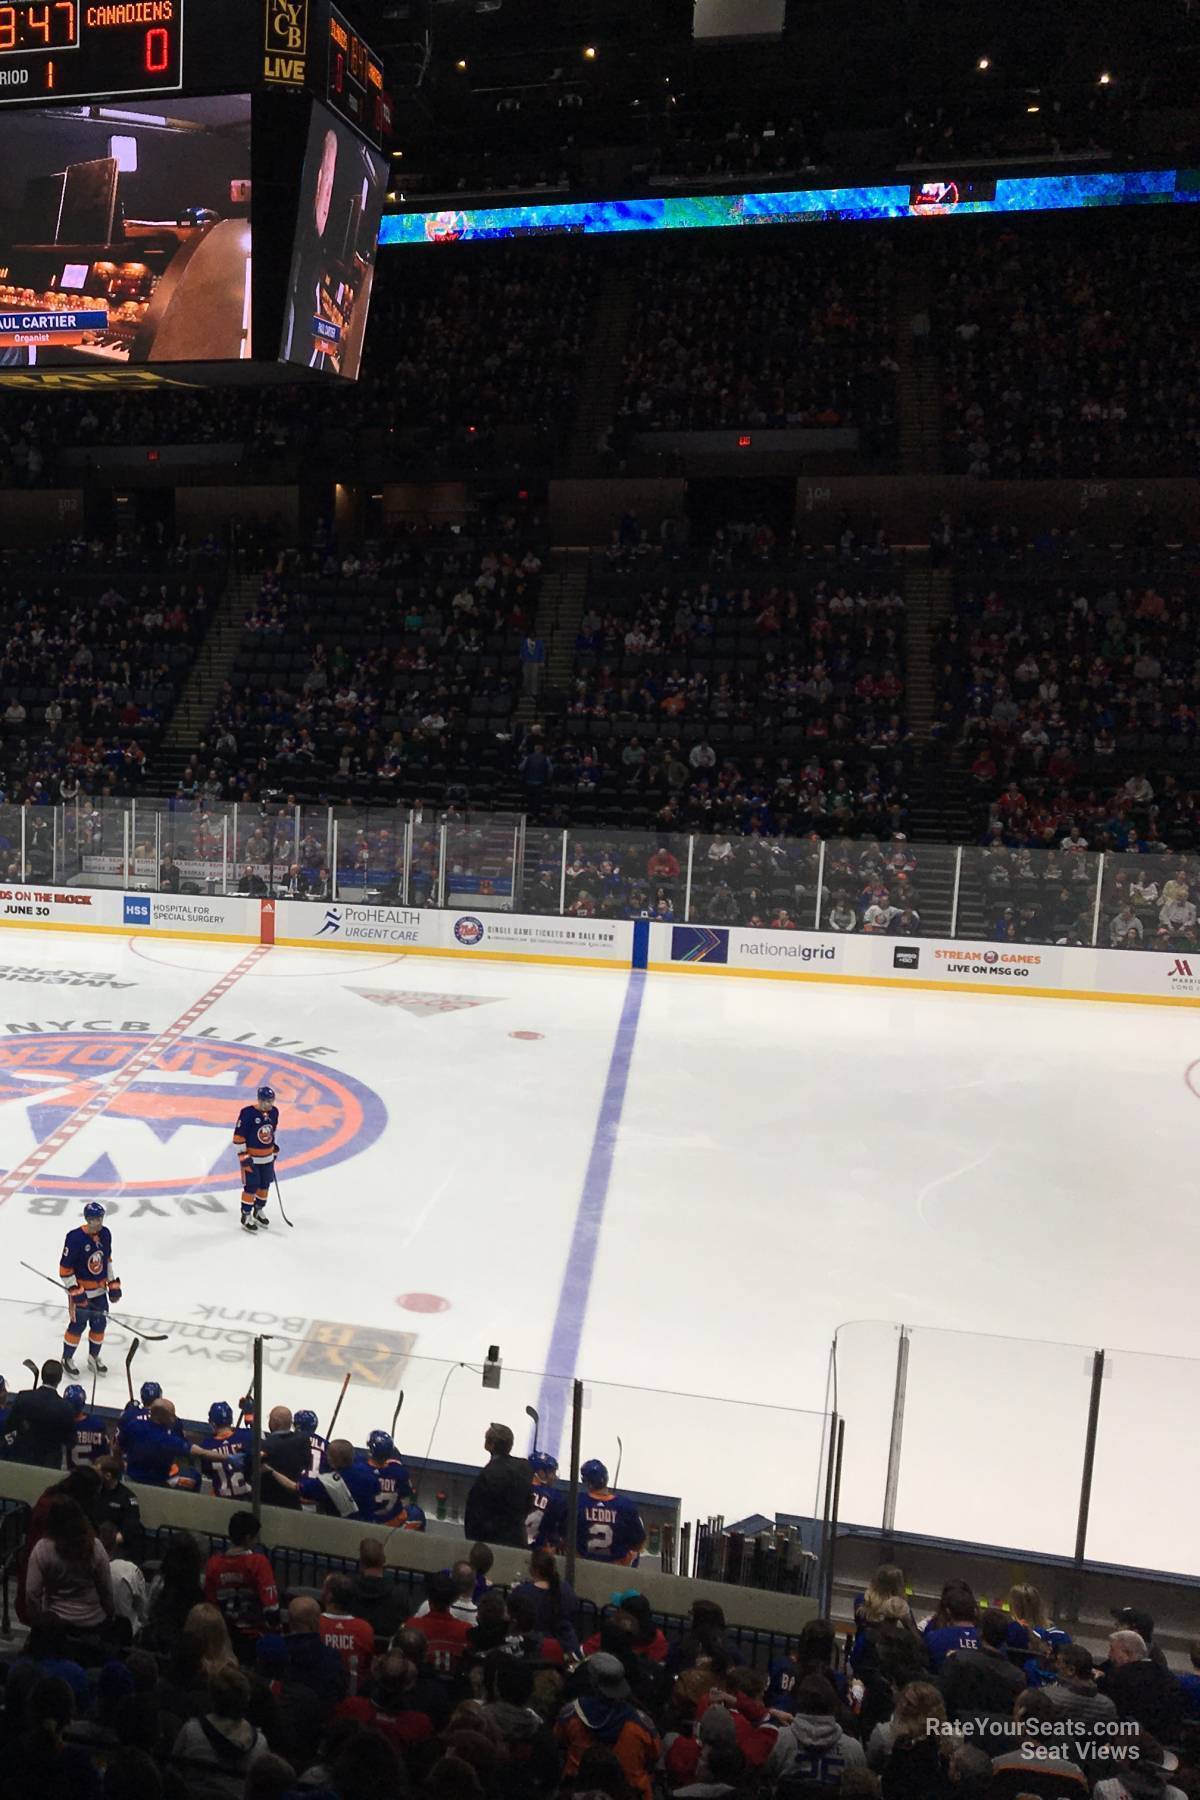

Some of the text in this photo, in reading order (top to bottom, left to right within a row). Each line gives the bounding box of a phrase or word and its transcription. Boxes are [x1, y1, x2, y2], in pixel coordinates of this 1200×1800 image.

[87, 1, 172, 27] CANADIENS
[146, 28, 169, 72] 0
[264, 57, 305, 80] LIVE
[22, 315, 77, 329] CARTIER
[14, 333, 50, 345] Organist
[15, 892, 32, 902] ON
[34, 893, 53, 903] THE
[4, 905, 50, 916] JUNE 30
[126, 906, 148, 916] HSS
[154, 904, 210, 915] HOSPITAL FOR
[346, 908, 420, 925] ProHEALTH
[154, 913, 225, 924] SPECIAL SURGERY
[345, 927, 419, 942] URGENT CARE
[740, 943, 836, 961] nationalgrid
[935, 950, 1041, 965] STREAM GAMES
[948, 964, 1029, 977] LIVE ON MSG GO
[5, 1020, 339, 1062] NYCB LIVE
[193, 1302, 310, 1334] Bank
[586, 1508, 618, 1524] LEDDY
[588, 1524, 613, 1555] 2
[325, 1634, 354, 1650] PRICE
[960, 1639, 978, 1650] LEE
